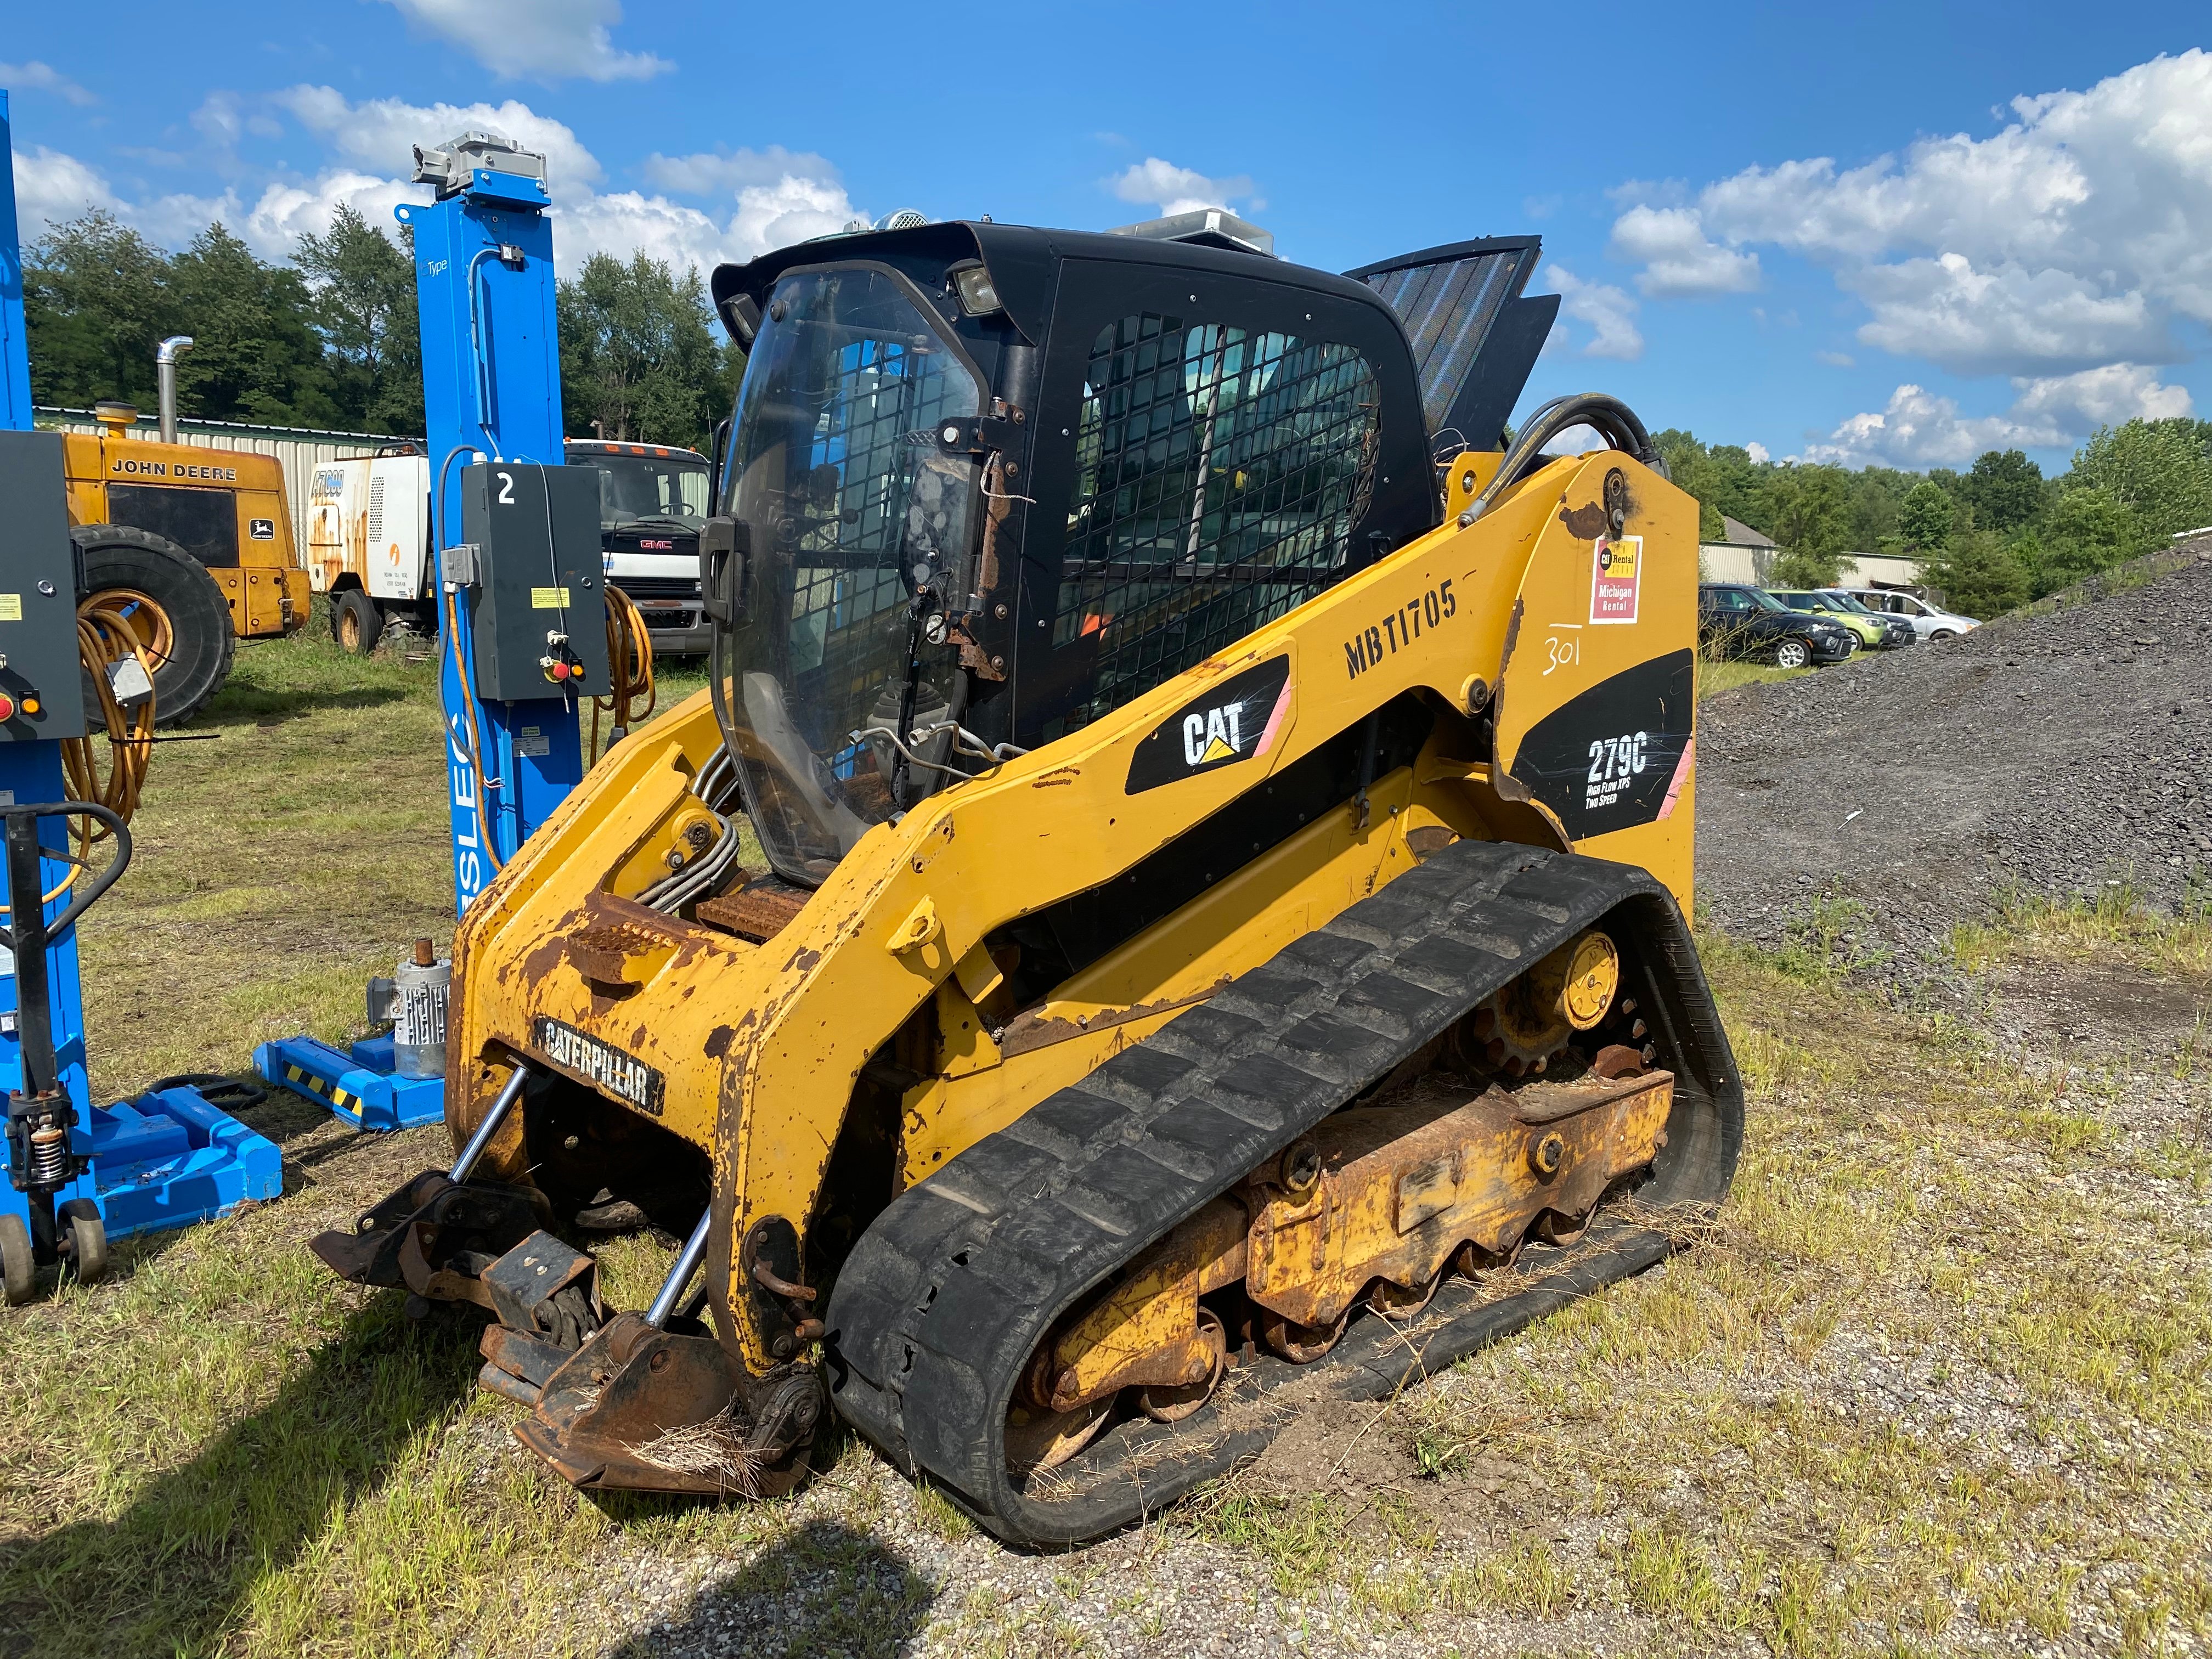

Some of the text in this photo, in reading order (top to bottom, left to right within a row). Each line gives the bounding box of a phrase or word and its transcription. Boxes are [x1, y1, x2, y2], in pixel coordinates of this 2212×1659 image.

[427, 259, 447, 278] Type
[111, 459, 236, 481] JOHN DEERE
[496, 472, 515, 504] 2
[640, 540, 673, 550] GMC
[1601, 554, 1611, 564] CAT
[1612, 555, 1634, 564] Rental
[1599, 584, 1632, 600] Michigan
[1602, 600, 1627, 611] Rental
[1543, 636, 1579, 676] 301
[1183, 701, 1243, 766] CAT
[1588, 731, 1647, 783] 279C
[1617, 776, 1631, 790] XPS
[546, 1022, 647, 1105] CATERPILLAR
